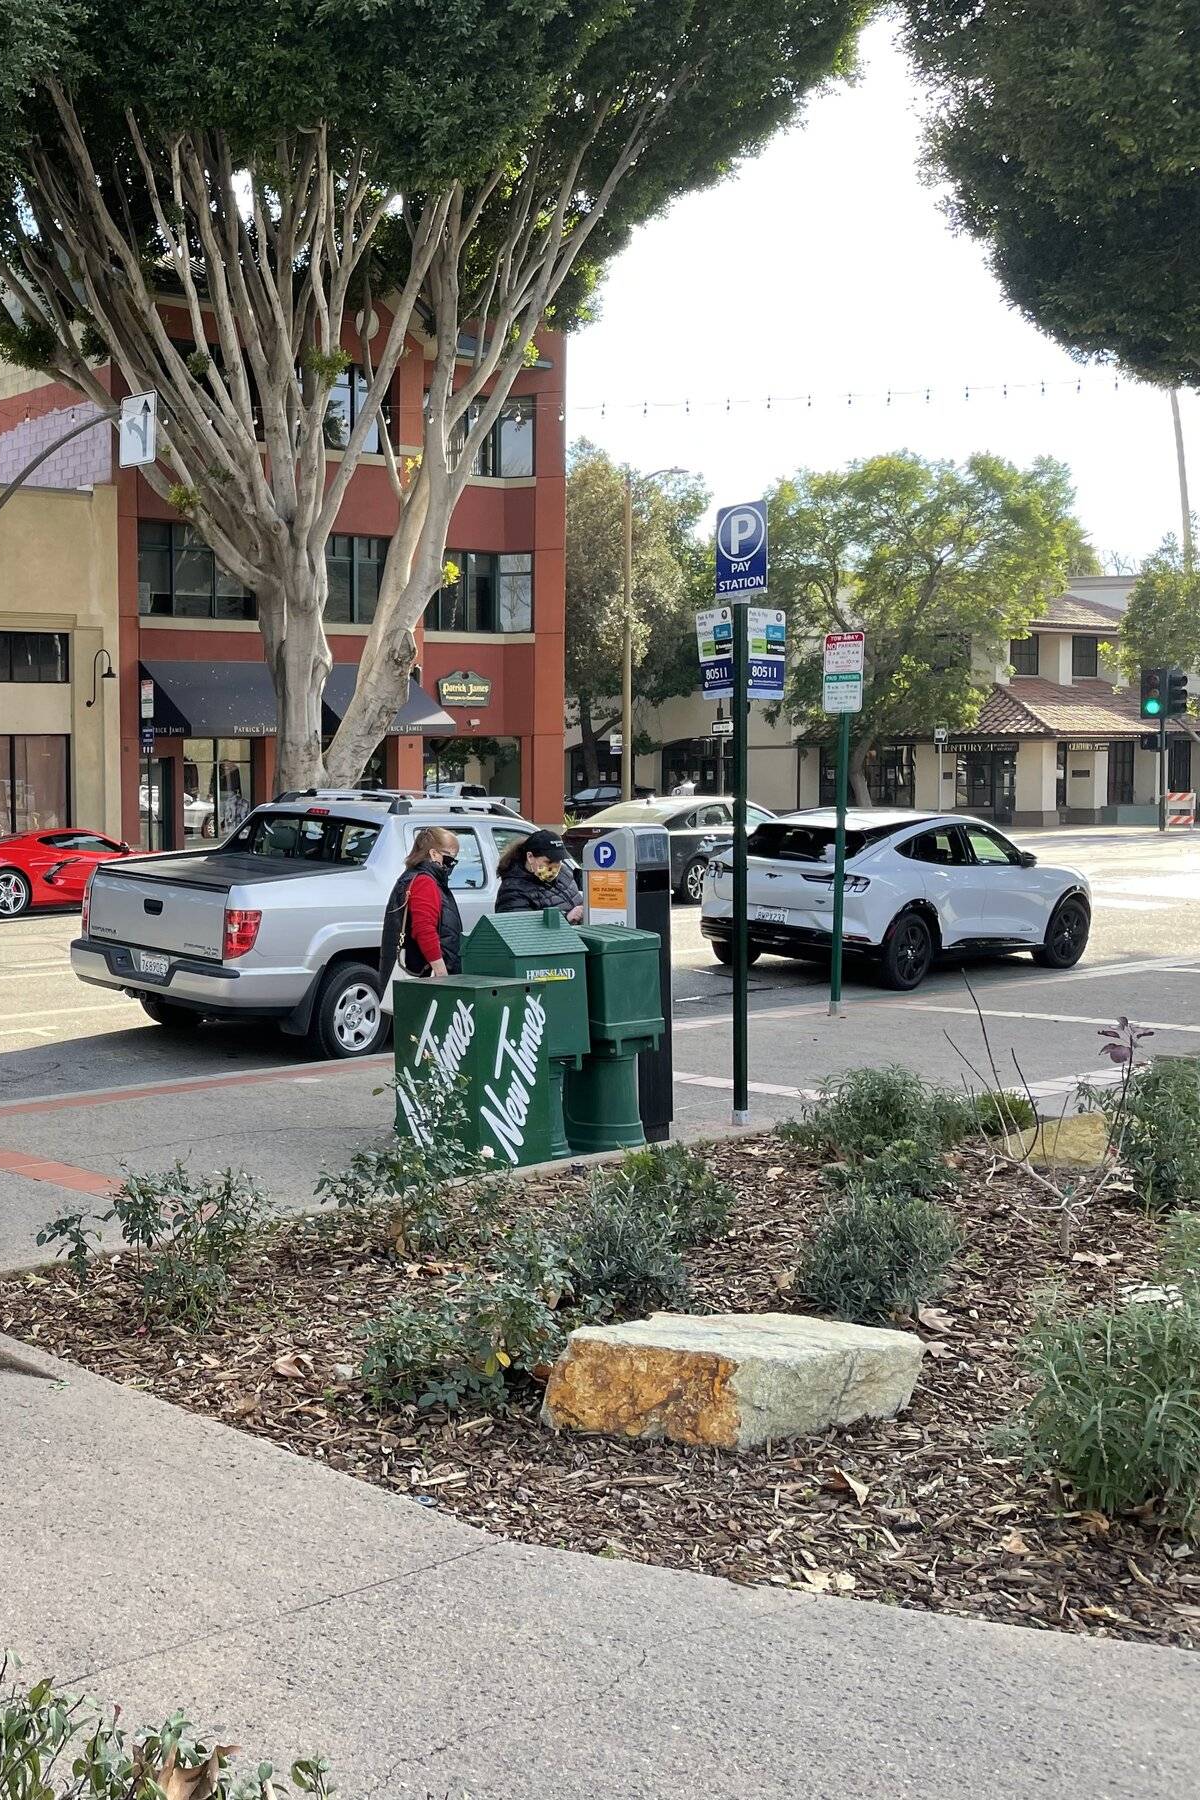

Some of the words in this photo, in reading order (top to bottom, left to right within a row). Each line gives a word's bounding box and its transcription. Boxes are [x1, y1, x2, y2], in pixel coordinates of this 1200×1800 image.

[730, 513, 757, 555] P
[731, 560, 751, 573] PAY
[719, 575, 764, 591] STATION
[705, 667, 728, 680] 80511
[751, 665, 777, 678] 80511
[443, 683, 467, 695] Patrick
[467, 683, 489, 695] James
[233, 725, 260, 734] PATRICK
[262, 724, 278, 735] JAME
[406, 725, 422, 733] JAMES
[943, 743, 982, 752] ENTURY
[599, 846, 612, 864] P
[414, 999, 476, 1092] Times
[494, 993, 547, 1087] Times
[479, 1069, 531, 1165] New
